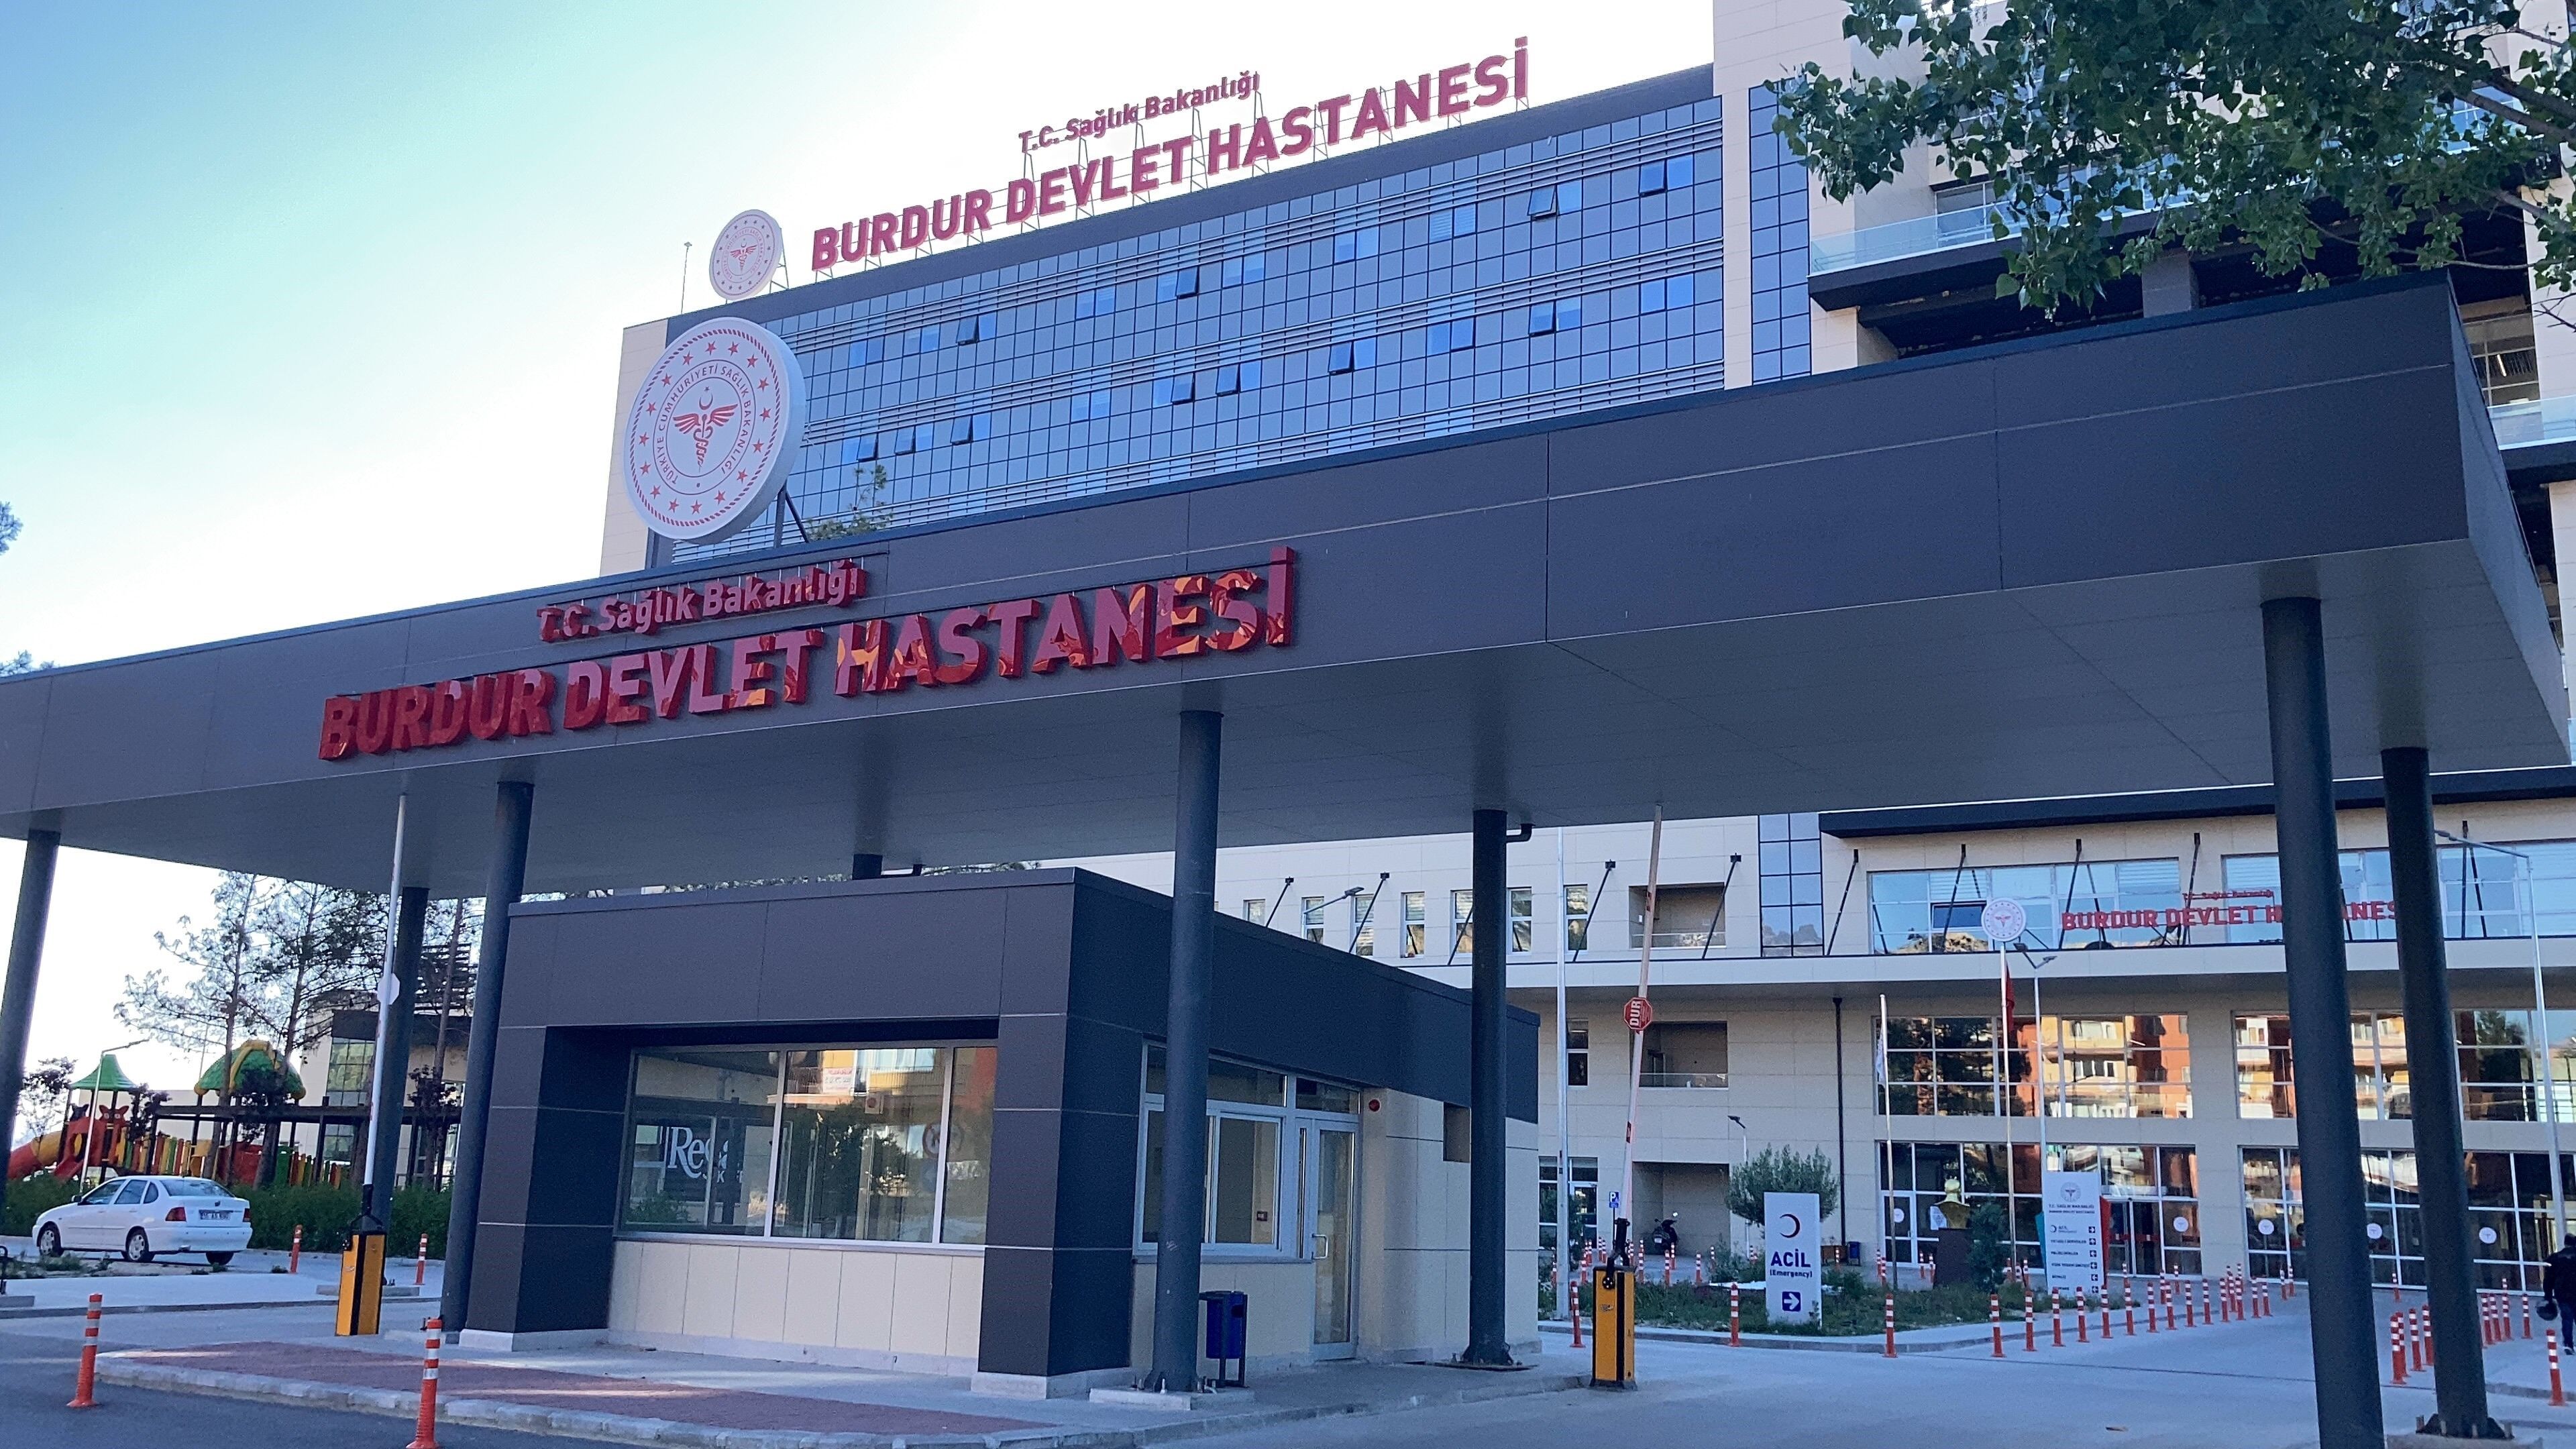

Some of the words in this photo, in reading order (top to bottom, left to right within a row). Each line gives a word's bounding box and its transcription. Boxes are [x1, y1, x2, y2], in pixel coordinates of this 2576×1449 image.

[1018, 130, 1060, 153] T.C.
[1066, 104, 1138, 140] Sağlık
[1145, 70, 1259, 120] Bakanlığı
[812, 189, 993, 270] BURDUR
[1007, 136, 1193, 225] DEVLET
[1208, 36, 1527, 175] HASTANESİ
[720, 366, 749, 398] SAĞLIK
[537, 604, 598, 643] T.C.
[597, 586, 702, 635] Sağlık
[702, 559, 869, 618] Bakanlığı
[319, 669, 555, 760] BURDUR
[563, 628, 825, 730] DEVLET
[835, 545, 1296, 698] HASTANESİ
[2062, 910, 2158, 930] BURDUR
[2165, 906, 2257, 927] DEVLET
[1629, 1001, 1641, 1026] DUR
[1770, 1248, 1811, 1268] ACİL
